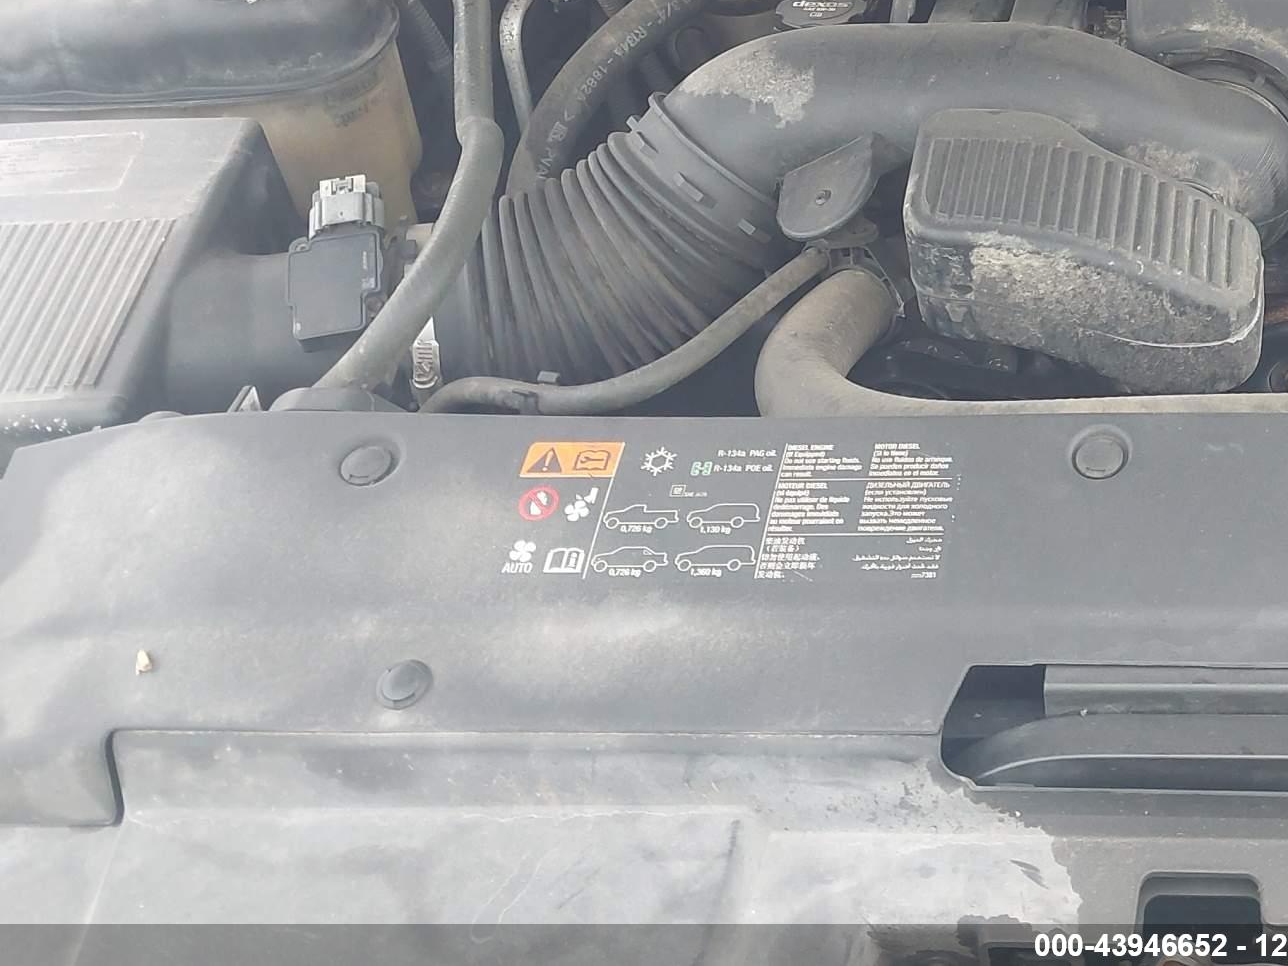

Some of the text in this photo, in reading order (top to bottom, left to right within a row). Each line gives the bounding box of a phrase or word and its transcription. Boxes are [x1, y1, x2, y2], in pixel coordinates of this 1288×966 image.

[717, 449, 746, 457] R-134a
[749, 449, 764, 457] PAG
[713, 464, 742, 472] R-134a
[745, 464, 761, 472] POE
[642, 525, 653, 534] kg
[720, 526, 732, 535] kg
[501, 562, 533, 573] AUTO
[630, 568, 641, 577] kg
[711, 568, 722, 577] kg
